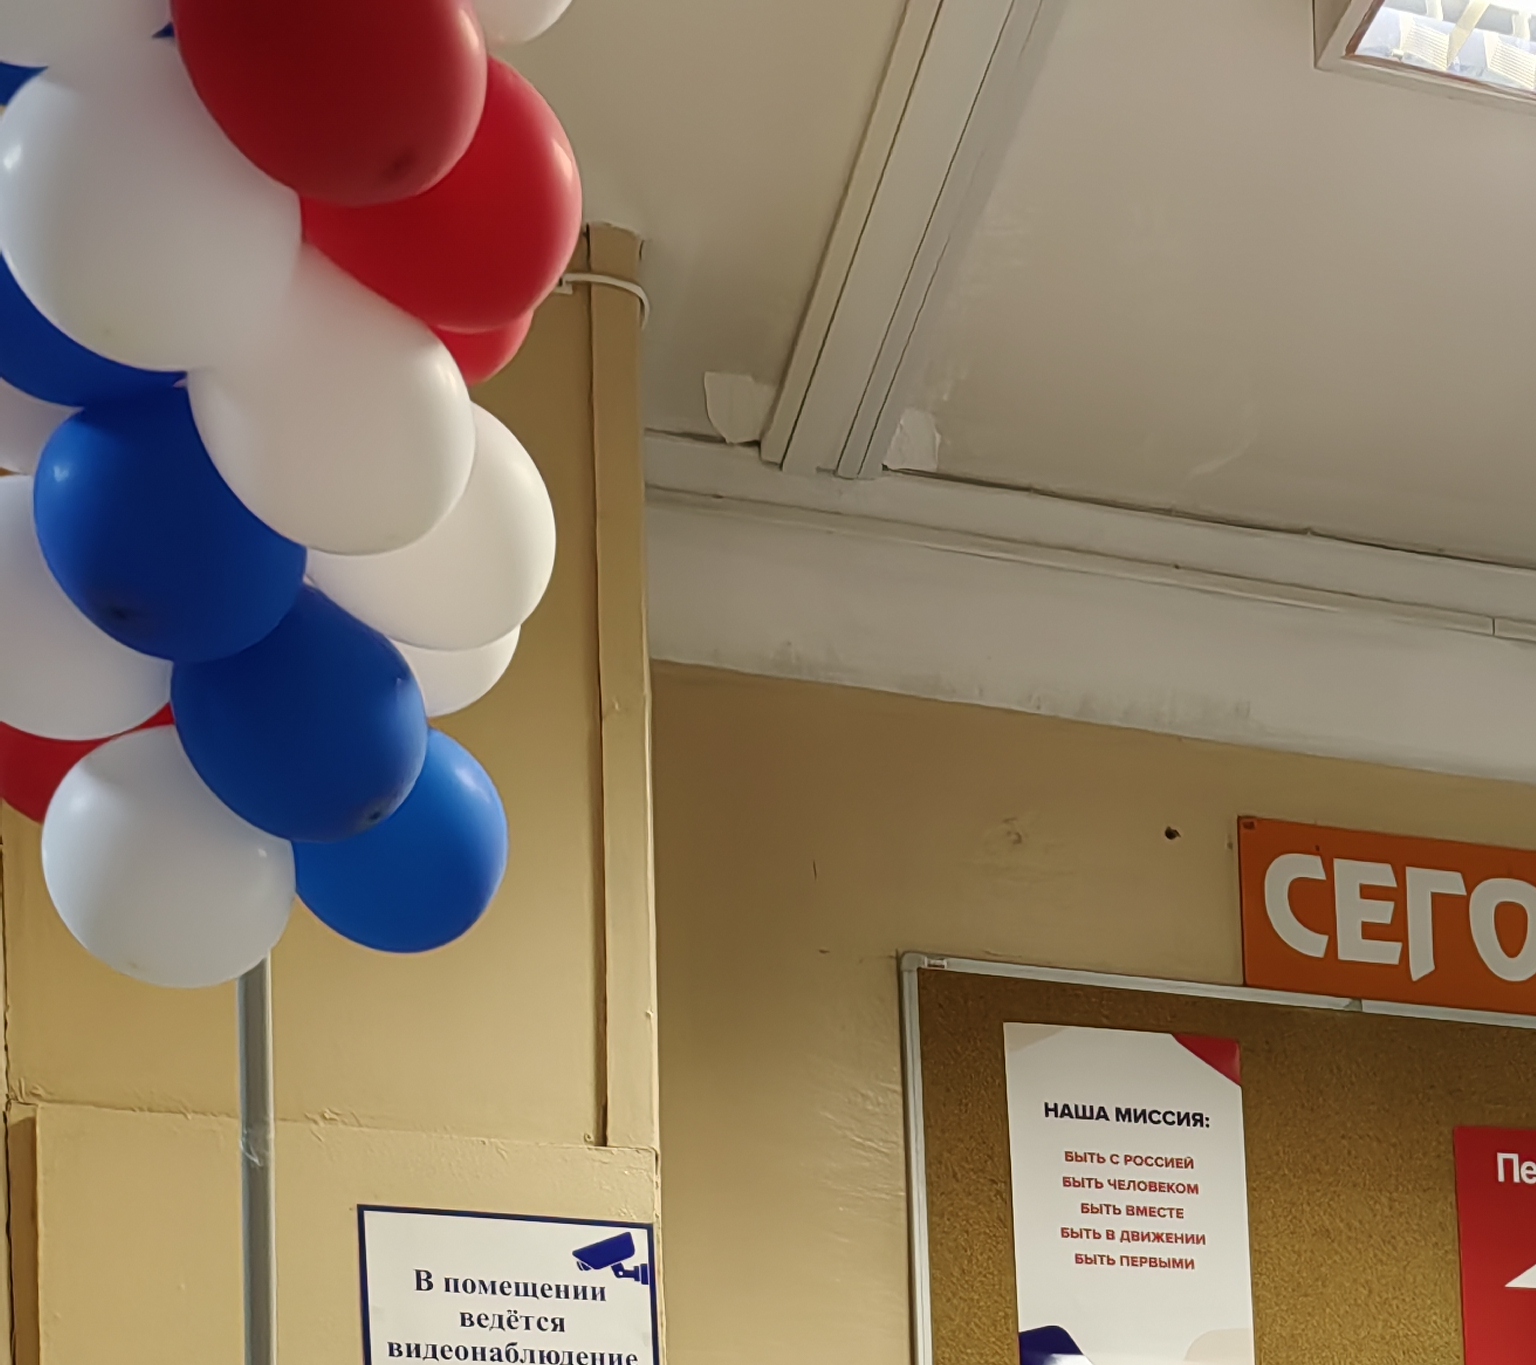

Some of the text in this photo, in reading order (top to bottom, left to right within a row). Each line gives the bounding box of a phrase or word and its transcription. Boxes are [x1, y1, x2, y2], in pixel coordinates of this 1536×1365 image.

[1044, 1102, 1210, 1128] НАША МИССИЯ:
[1064, 1151, 1194, 1169] БЫТЬ С РОССИЕЙ
[1063, 1177, 1198, 1194] БЫТЬ ЧЕЛОВЕКОМ
[1081, 1203, 1184, 1219] БЫТЬ ВМЕСТЕ
[1061, 1227, 1206, 1245] БЫТЬ В ДВИЖЕНИИ
[1075, 1253, 1195, 1269] БЫТЬ ПЕРВЫМИ
[414, 1269, 606, 1301] В помещении
[460, 1310, 565, 1332] ведётся
